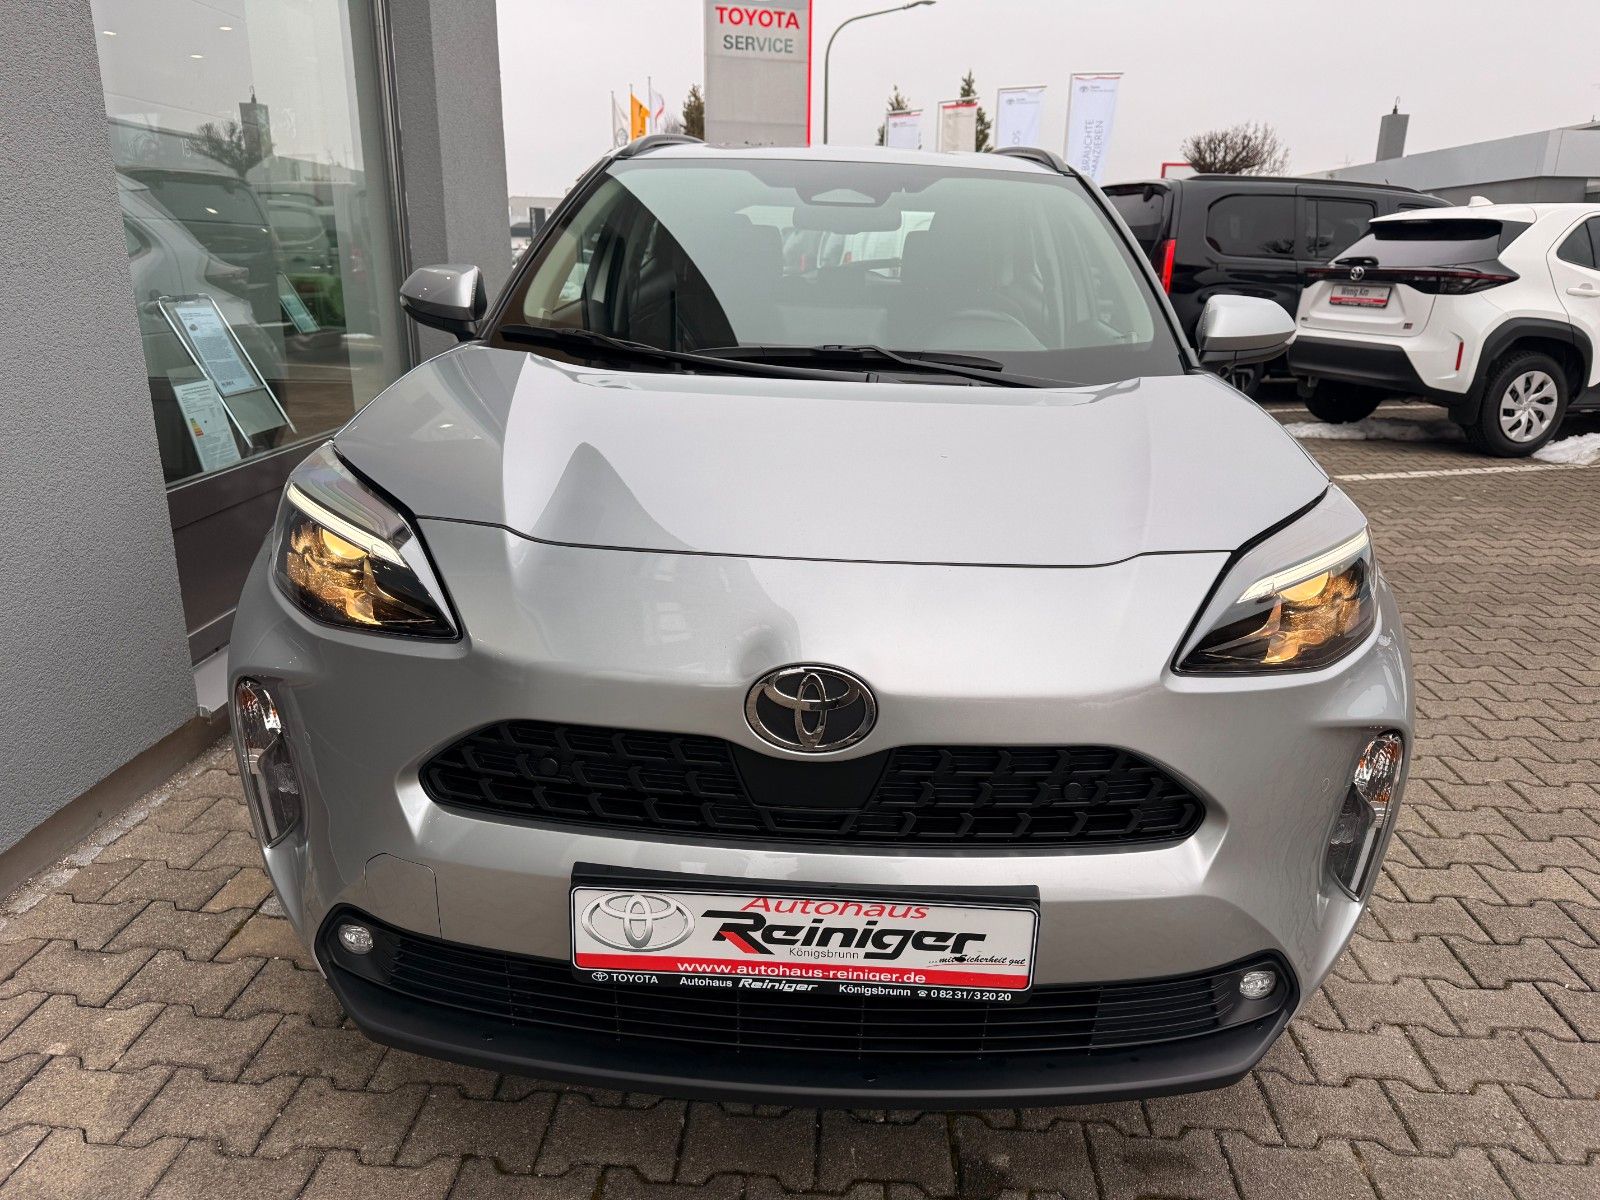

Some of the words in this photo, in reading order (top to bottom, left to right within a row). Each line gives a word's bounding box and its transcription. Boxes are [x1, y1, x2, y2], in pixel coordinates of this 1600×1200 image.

[715, 6, 800, 29] TOYOTA
[723, 34, 794, 54] SERVICE
[1081, 119, 1095, 172] BRAUCHTE
[741, 896, 930, 919] Autohaus
[701, 909, 987, 960] Reiniger
[789, 947, 860, 960] Königsbrunn
[1008, 958, 1026, 966] gut
[677, 961, 927, 984] www.autohaus-reiniger.de
[611, 973, 659, 984] TOYOTA
[680, 976, 733, 988] Autohaus
[738, 978, 819, 992] Reiniger
[839, 984, 912, 997] Königsbrunn
